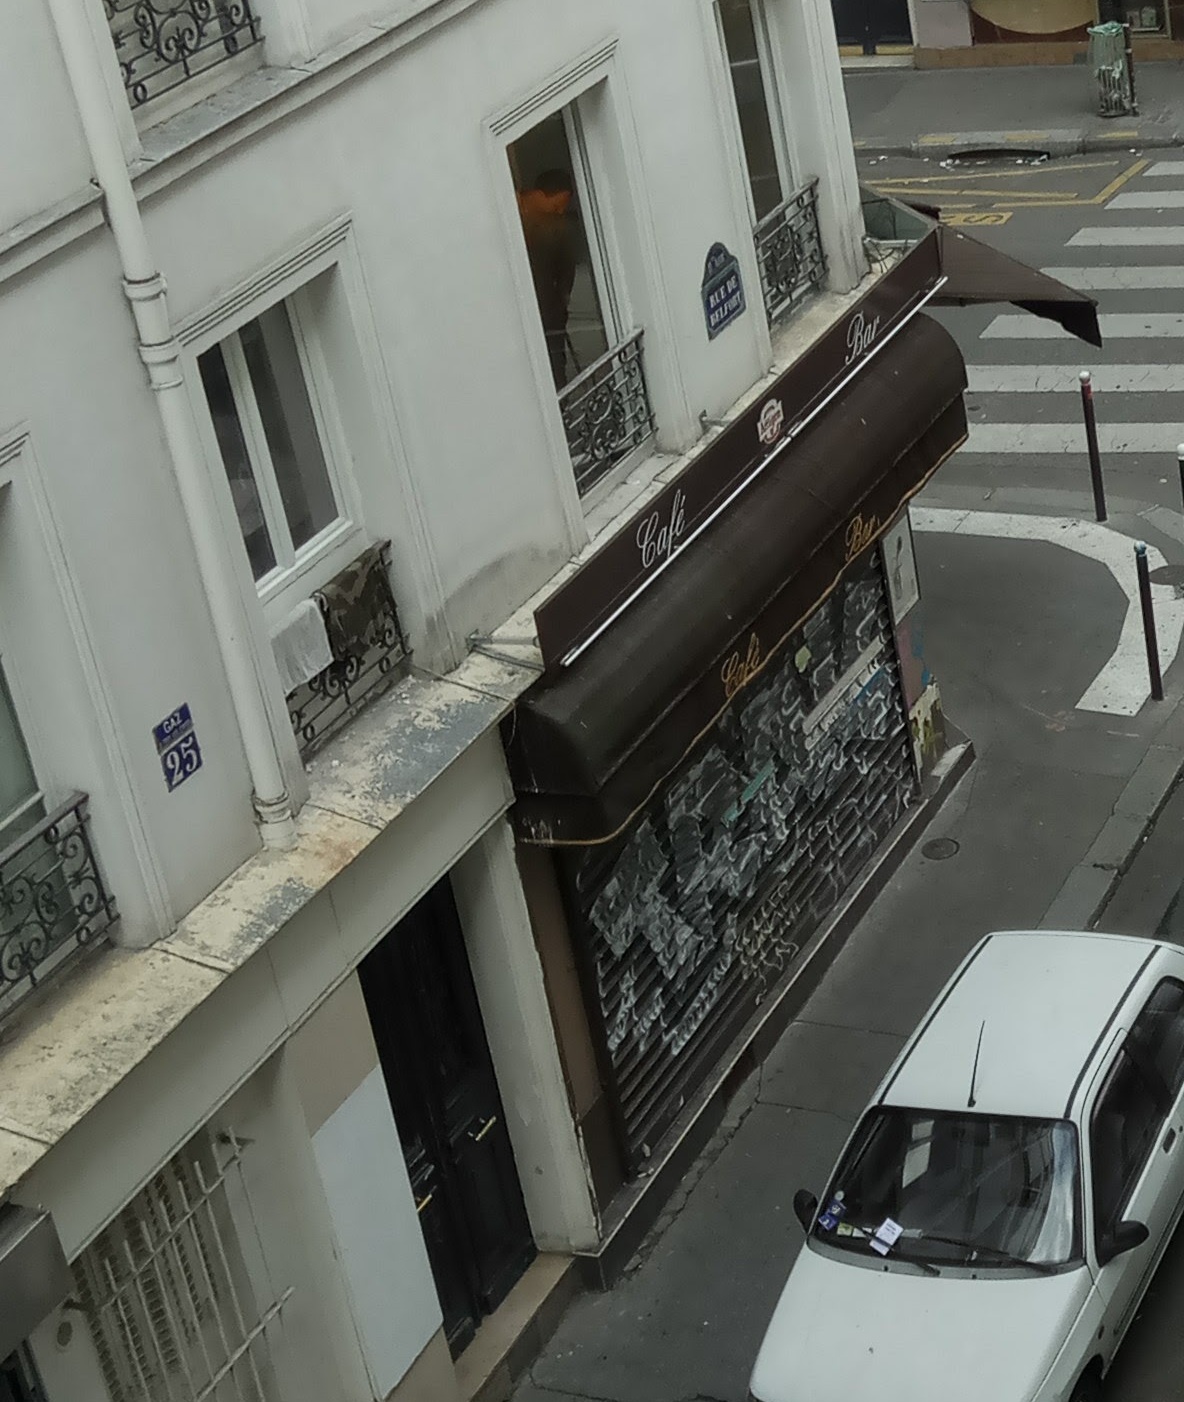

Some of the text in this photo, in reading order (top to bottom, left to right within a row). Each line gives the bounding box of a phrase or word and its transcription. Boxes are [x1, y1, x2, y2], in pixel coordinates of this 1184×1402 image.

[708, 275, 738, 309] RUE DE
[845, 310, 880, 365] Bar
[636, 488, 686, 568] Café
[163, 712, 183, 734] GAZ
[166, 736, 198, 786] 25
